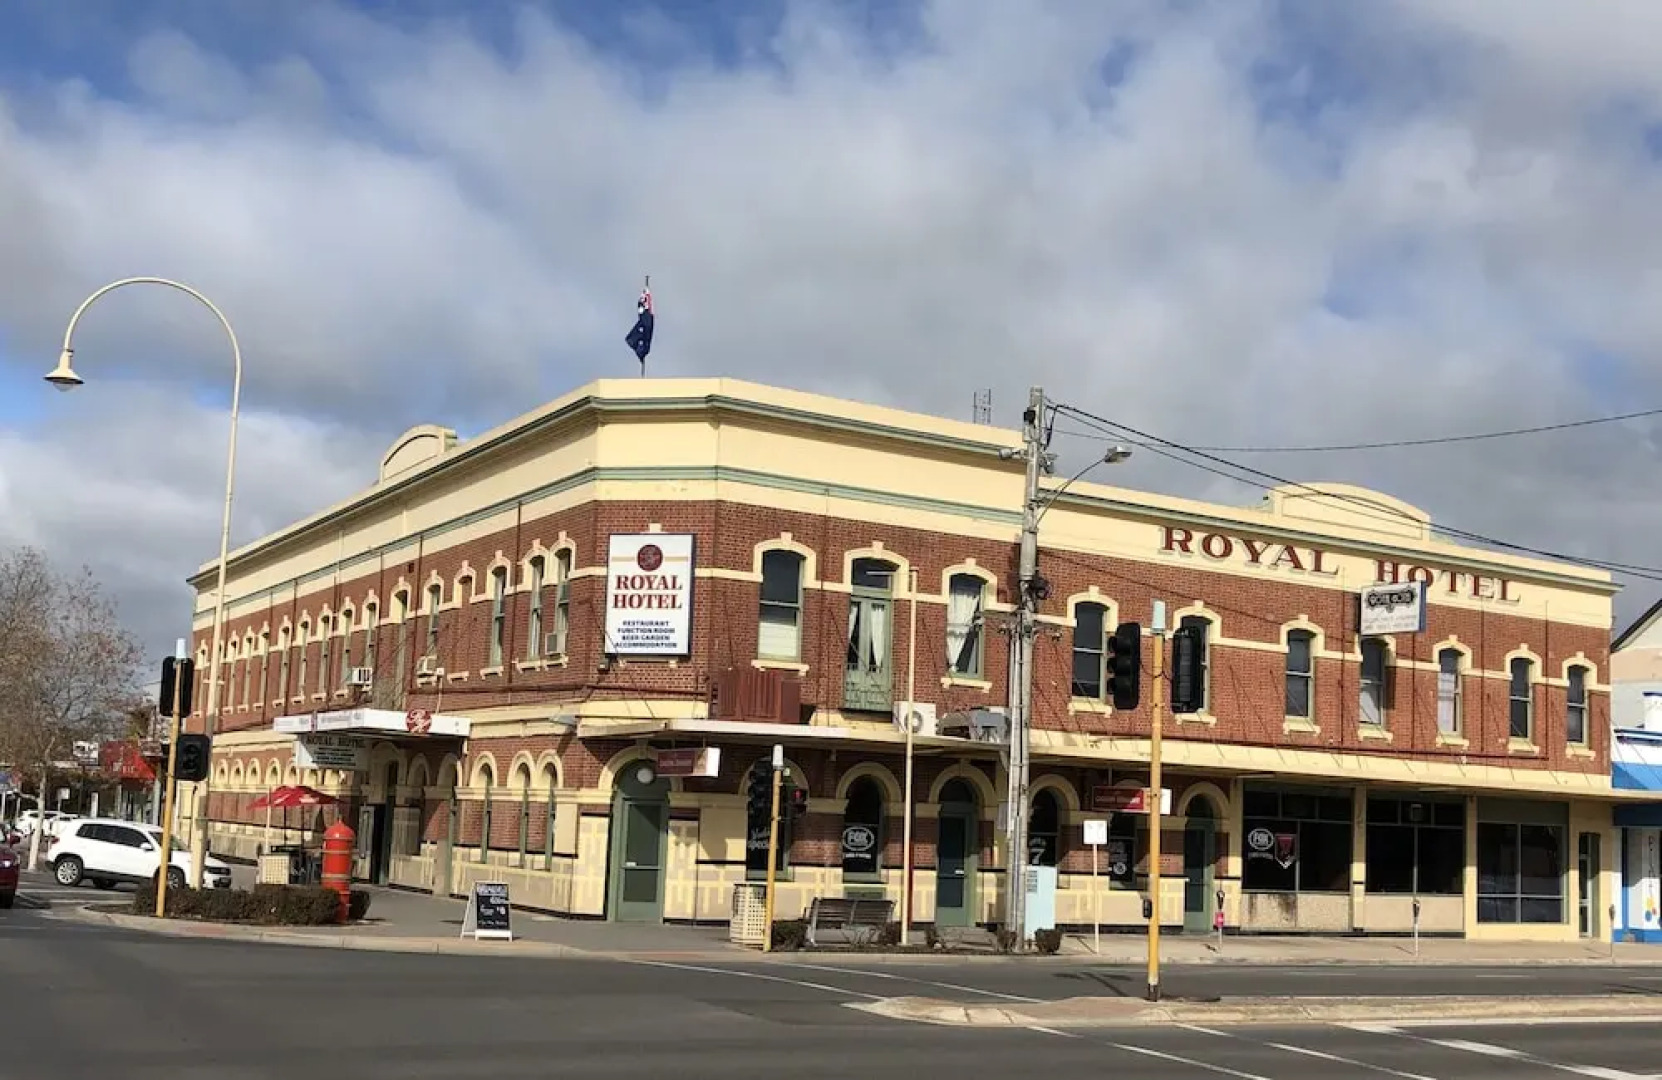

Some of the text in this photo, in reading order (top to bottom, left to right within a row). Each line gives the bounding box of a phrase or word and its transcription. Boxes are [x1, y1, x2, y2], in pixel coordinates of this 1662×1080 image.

[1160, 526, 1521, 604] ROYAL HOTEL
[615, 575, 683, 591] ROYAL
[613, 594, 683, 609] HOTEL
[847, 829, 868, 846] FOX
